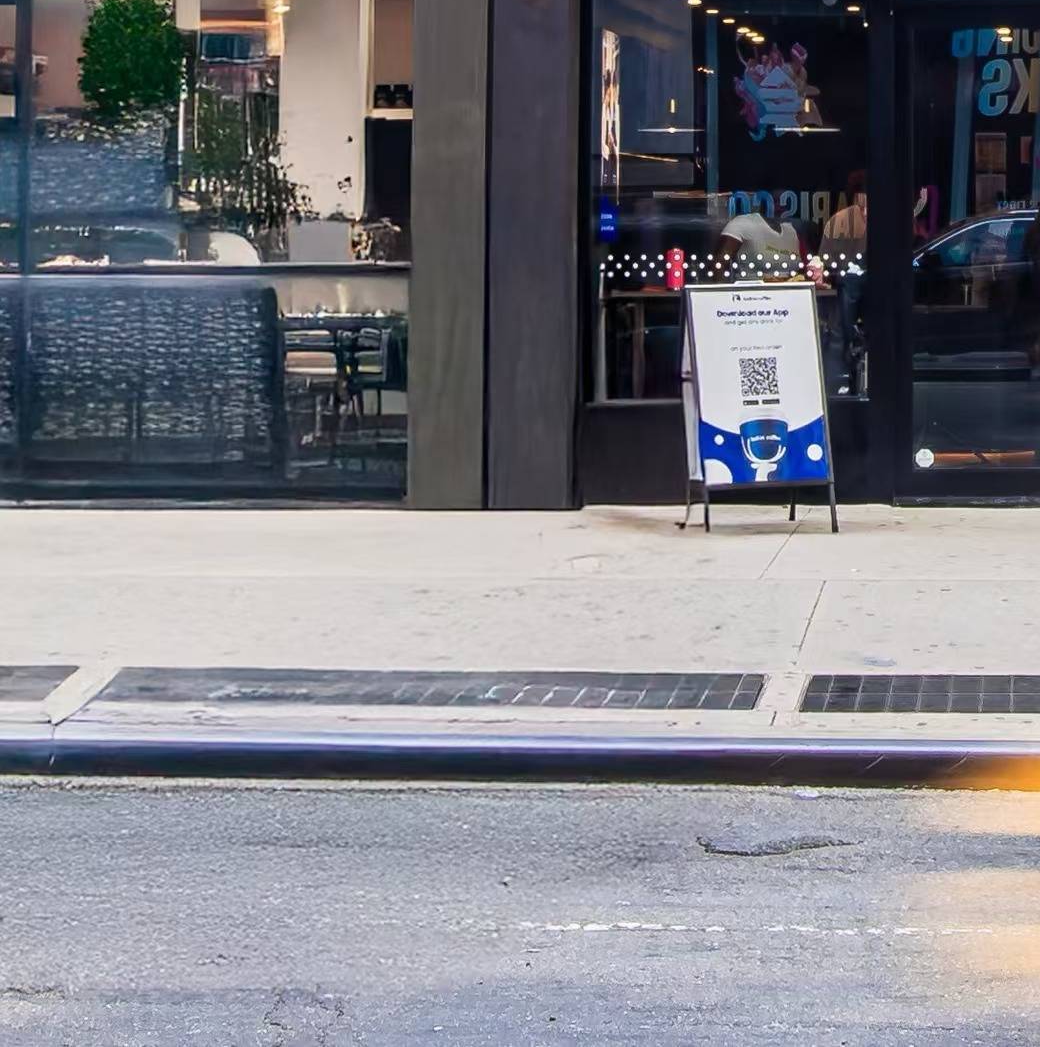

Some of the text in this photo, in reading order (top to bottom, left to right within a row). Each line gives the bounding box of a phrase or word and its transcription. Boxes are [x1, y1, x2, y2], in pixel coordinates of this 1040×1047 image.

[716, 308, 789, 318] Download our App
